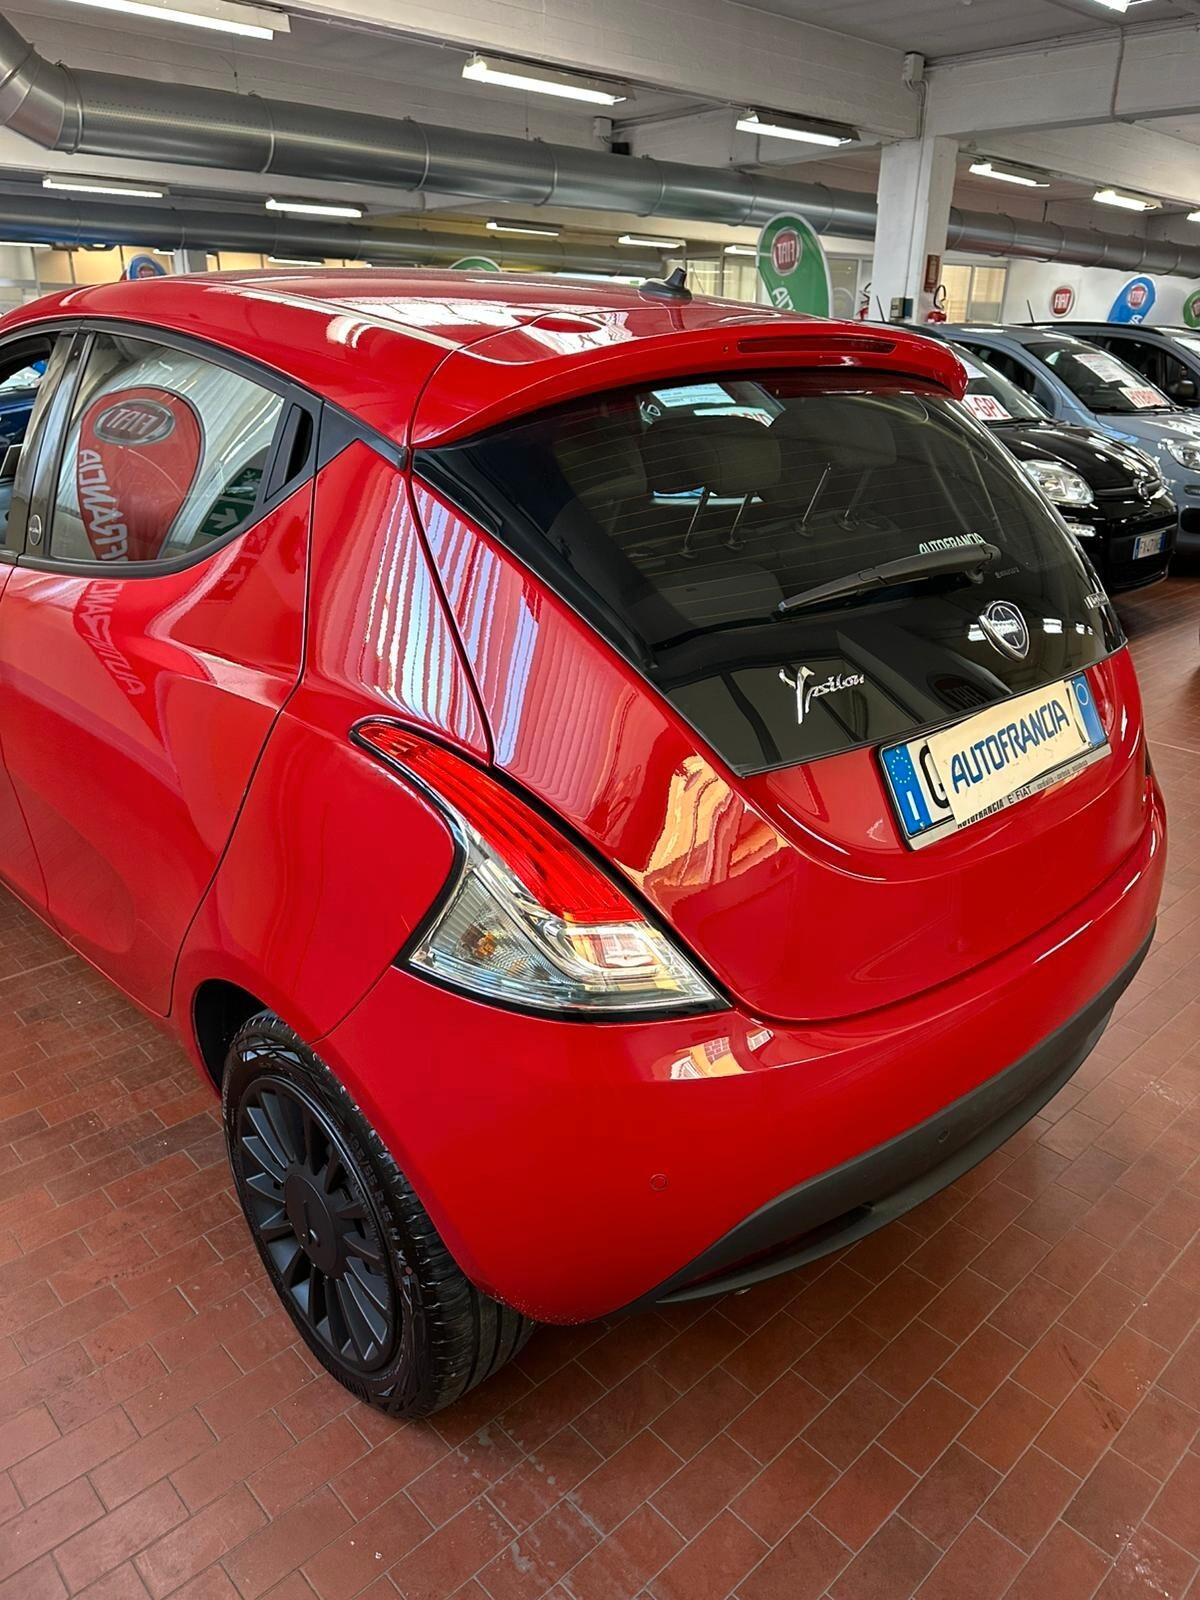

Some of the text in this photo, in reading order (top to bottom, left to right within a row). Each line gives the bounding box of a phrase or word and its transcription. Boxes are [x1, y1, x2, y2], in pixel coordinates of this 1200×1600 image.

[1054, 293, 1071, 309] FIAT
[779, 666, 864, 724] Ypsilon
[950, 699, 1071, 795] AUTOFRANCIA
[1016, 785, 1034, 801] FIAT
